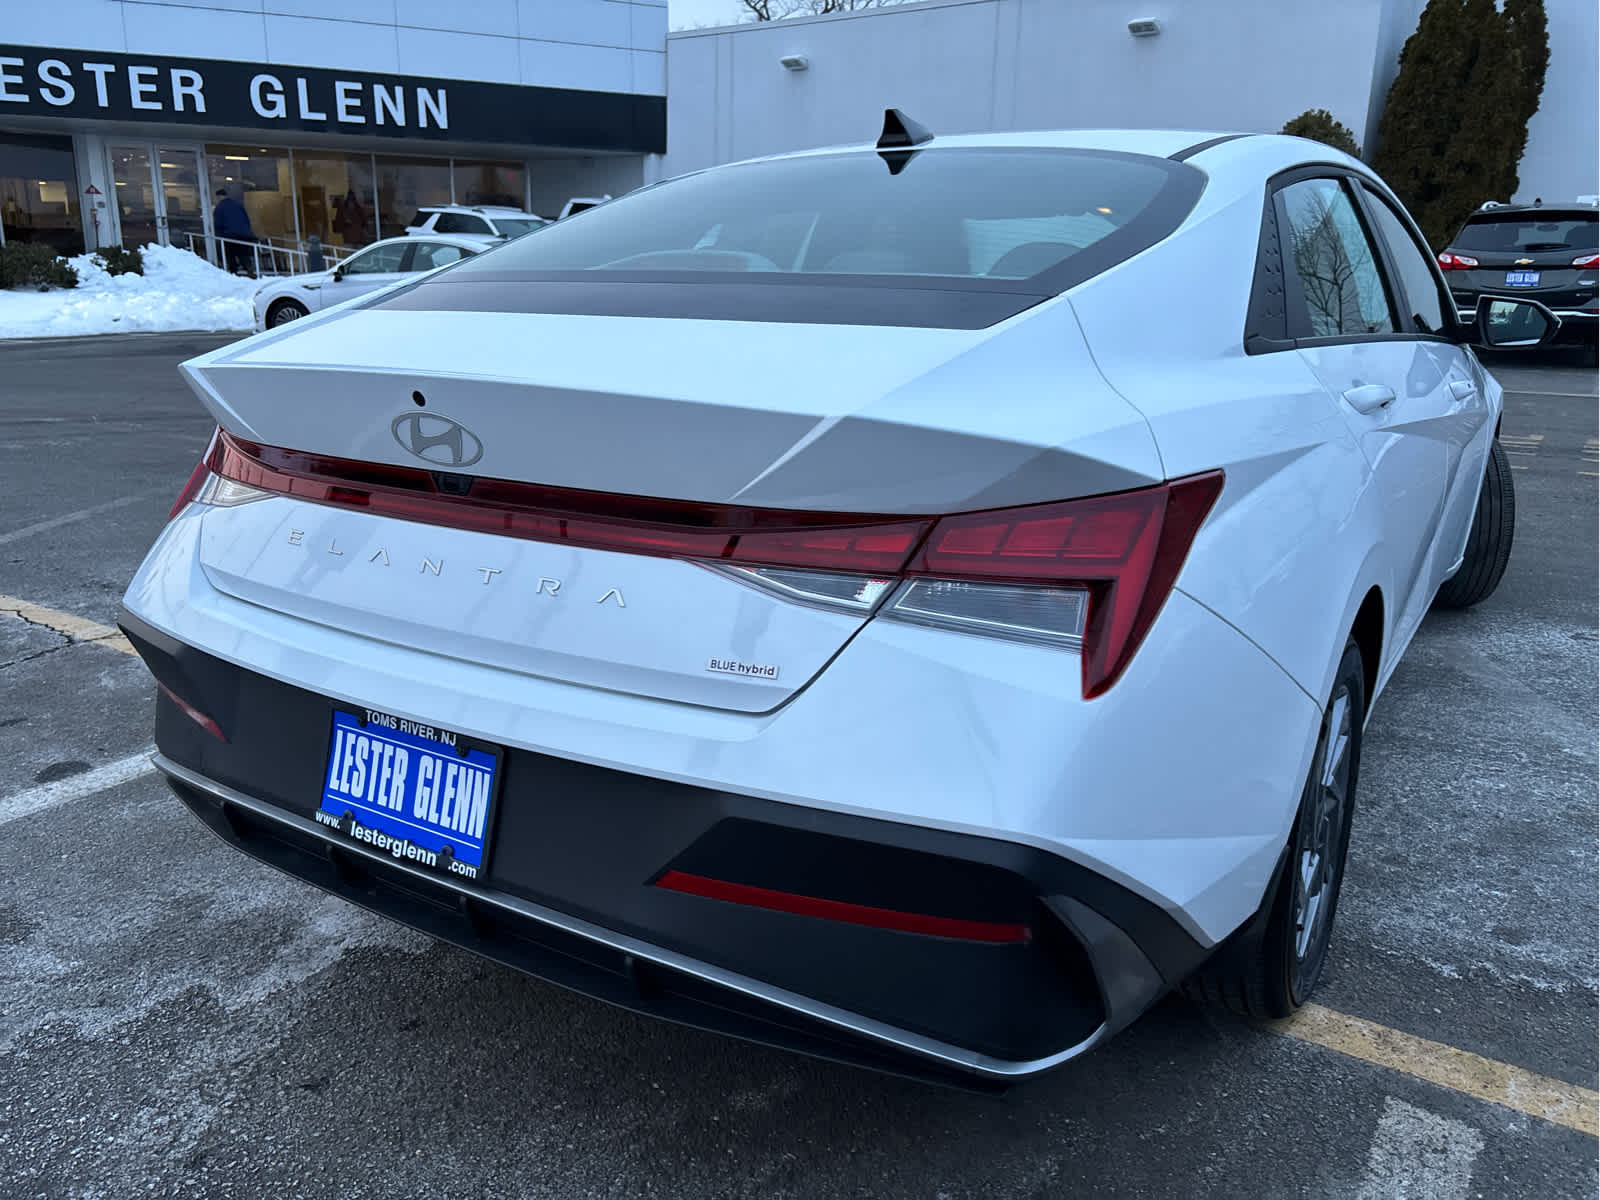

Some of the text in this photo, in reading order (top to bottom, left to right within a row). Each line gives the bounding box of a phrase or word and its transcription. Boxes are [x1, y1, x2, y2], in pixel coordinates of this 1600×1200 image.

[249, 73, 449, 129] GLENN
[287, 529, 626, 607] ELANTRA
[710, 659, 775, 676] BLUE hybrid
[366, 710, 457, 747] TOMS RIVER, NJ
[329, 729, 491, 839] LESTER GLENN
[315, 811, 476, 879] www. lesterglenn .com
